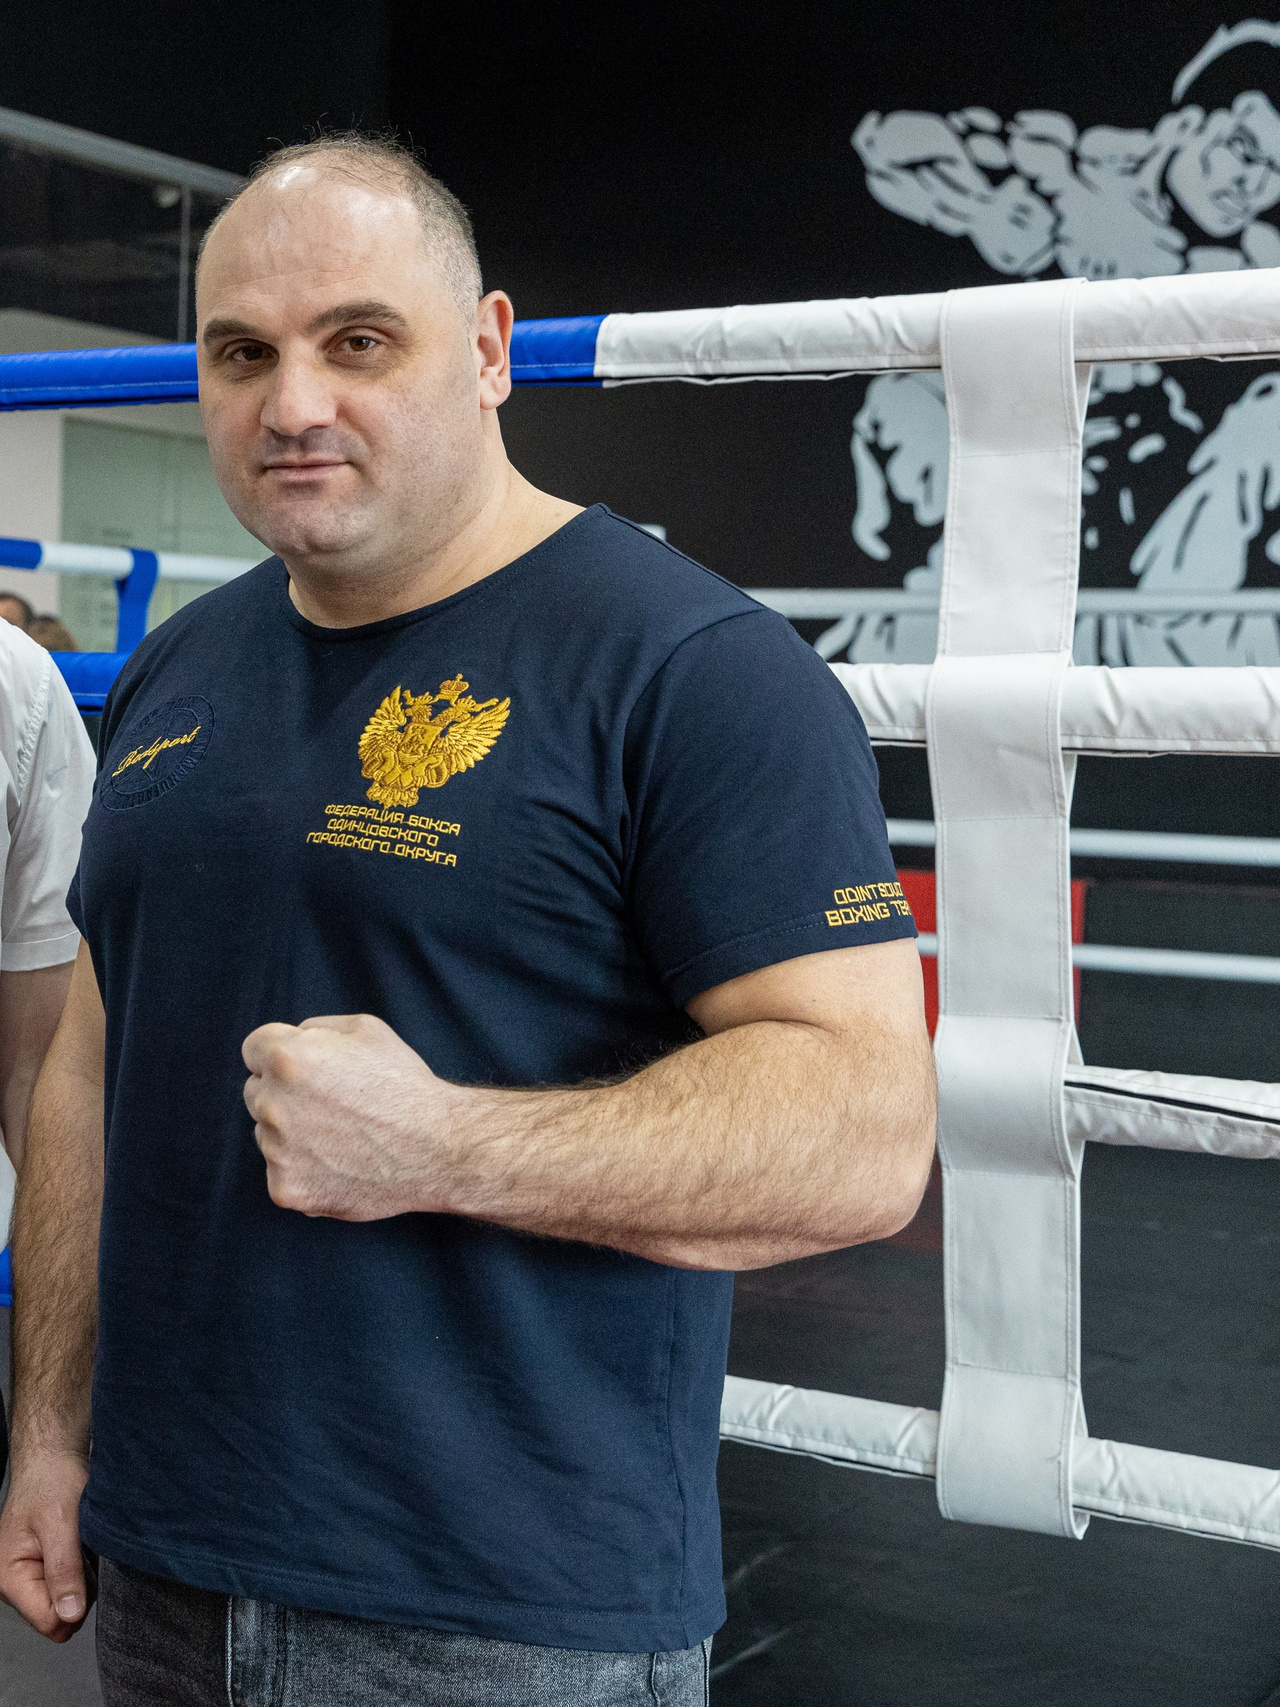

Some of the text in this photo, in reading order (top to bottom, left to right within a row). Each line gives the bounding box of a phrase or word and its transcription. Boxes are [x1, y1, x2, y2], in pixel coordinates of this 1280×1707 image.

[325, 804, 461, 836] ФЕДЕРАЦИЯ БОКСА
[327, 818, 439, 847] ОДИНЦОВСКОГО
[306, 832, 457, 867] ГОРОДСКОГО ОКРУГА
[825, 902, 891, 927] BOXING
